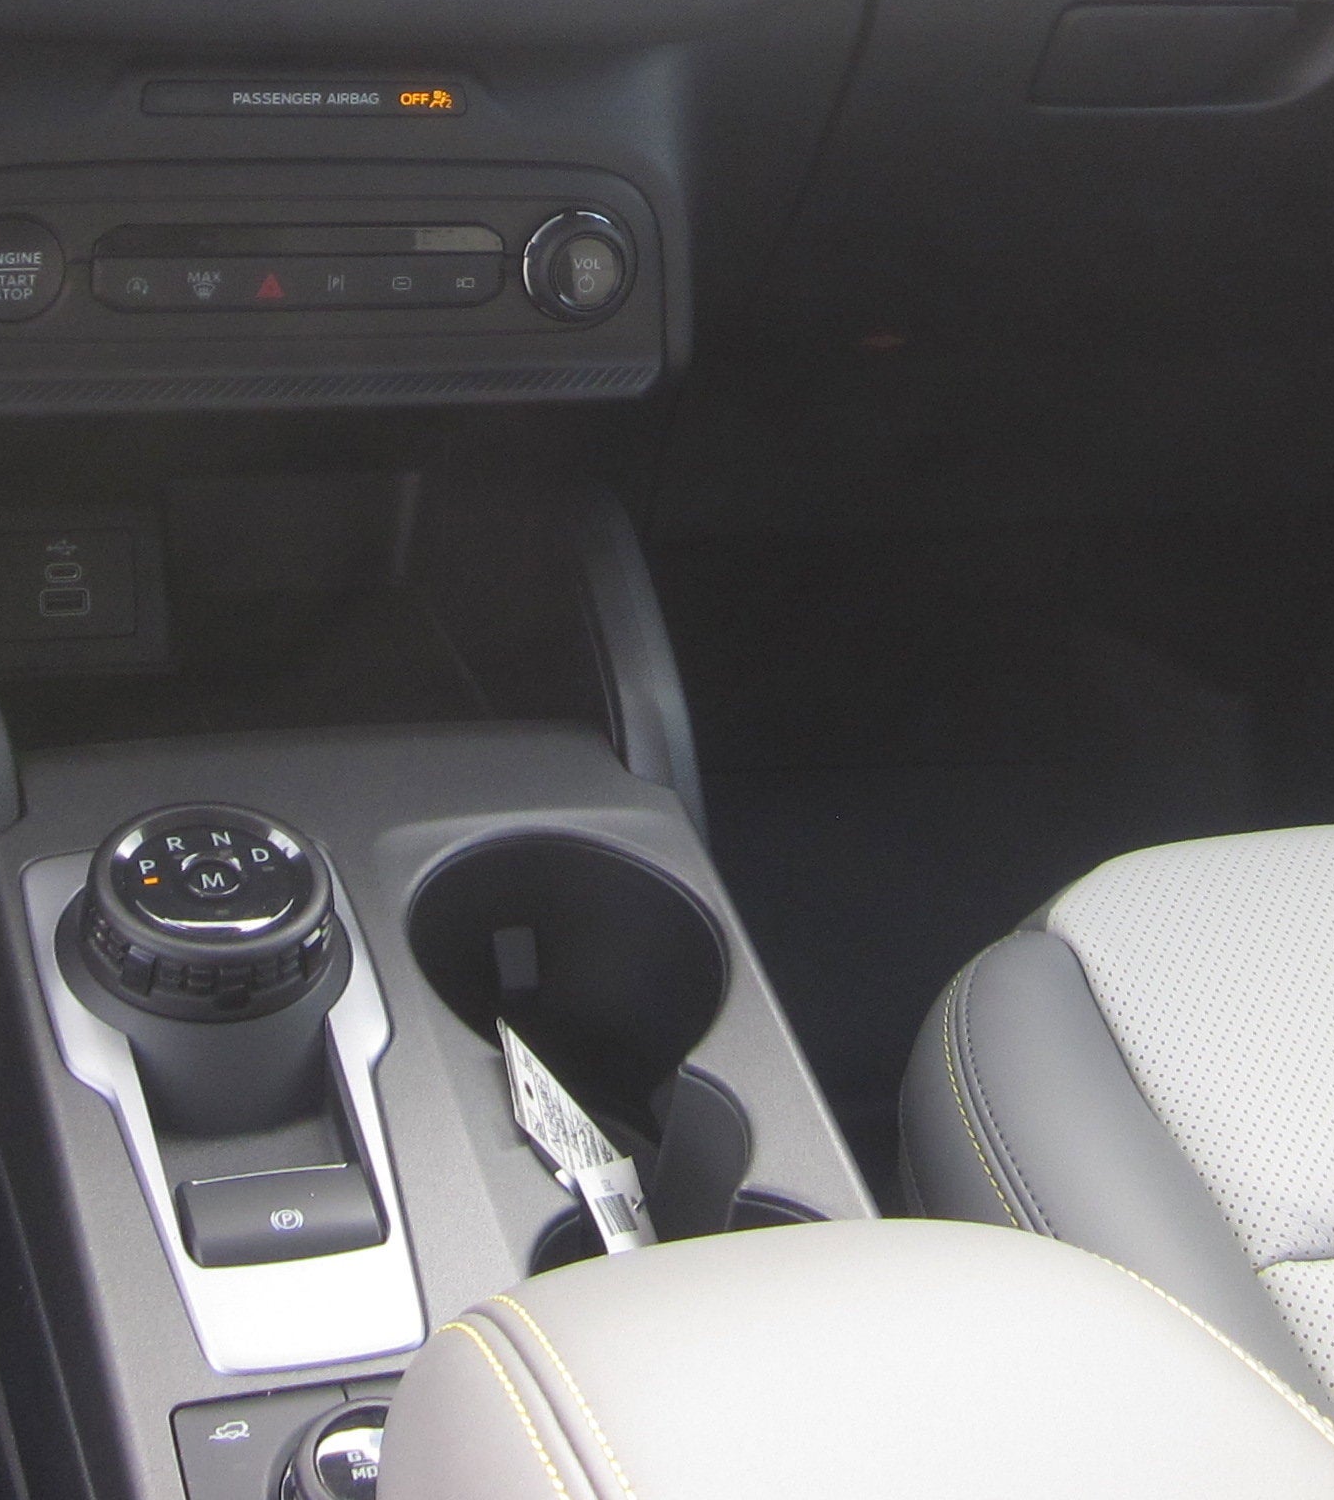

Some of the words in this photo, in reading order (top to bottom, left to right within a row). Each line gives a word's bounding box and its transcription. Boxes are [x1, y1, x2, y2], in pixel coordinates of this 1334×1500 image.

[232, 92, 322, 105] PASSENGER
[326, 92, 380, 105] AIRBAG
[400, 92, 430, 106] OFF
[574, 258, 601, 270] VOL
[187, 271, 222, 283] MAX
[139, 859, 155, 875] P
[166, 836, 185, 851] R
[211, 831, 232, 846] N
[251, 848, 269, 863] D
[201, 873, 225, 888] M
